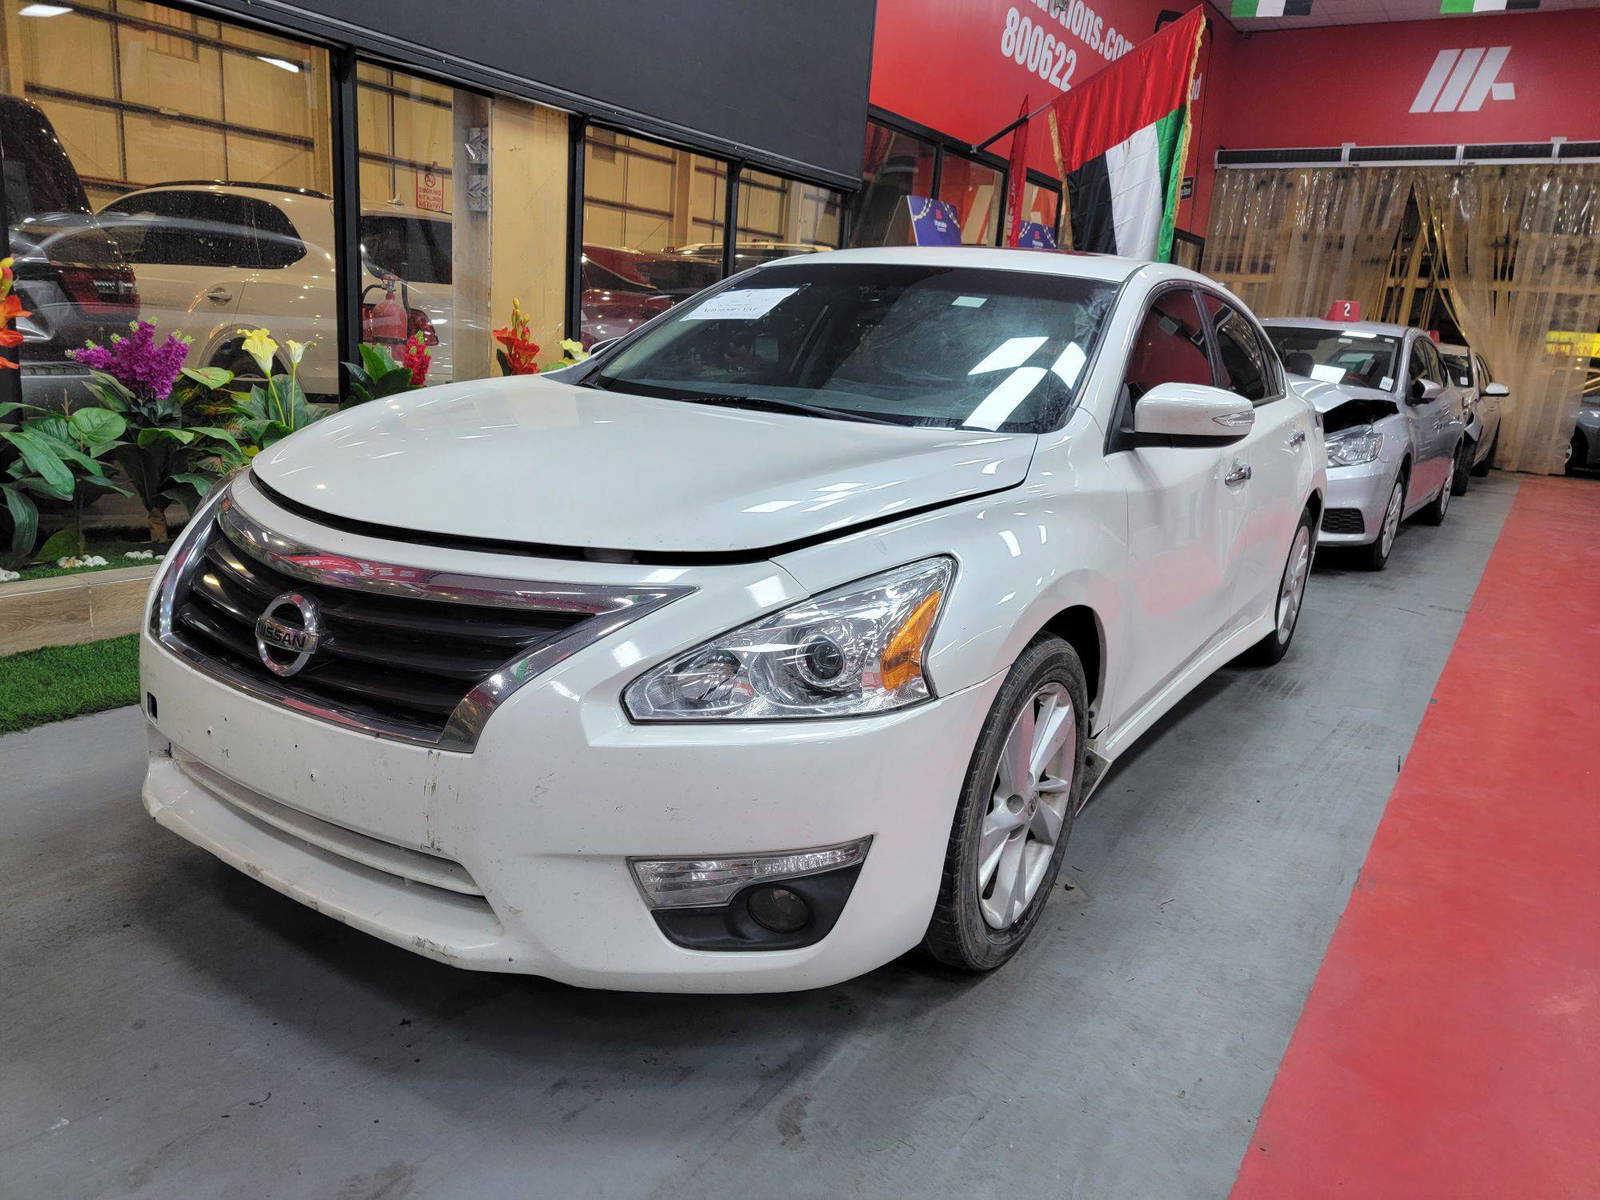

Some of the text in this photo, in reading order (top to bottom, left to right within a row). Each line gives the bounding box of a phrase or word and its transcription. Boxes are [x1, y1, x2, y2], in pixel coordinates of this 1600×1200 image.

[1001, 7, 1077, 92] 800622
[1344, 303, 1351, 316] 2
[258, 622, 306, 647] NISSAN
